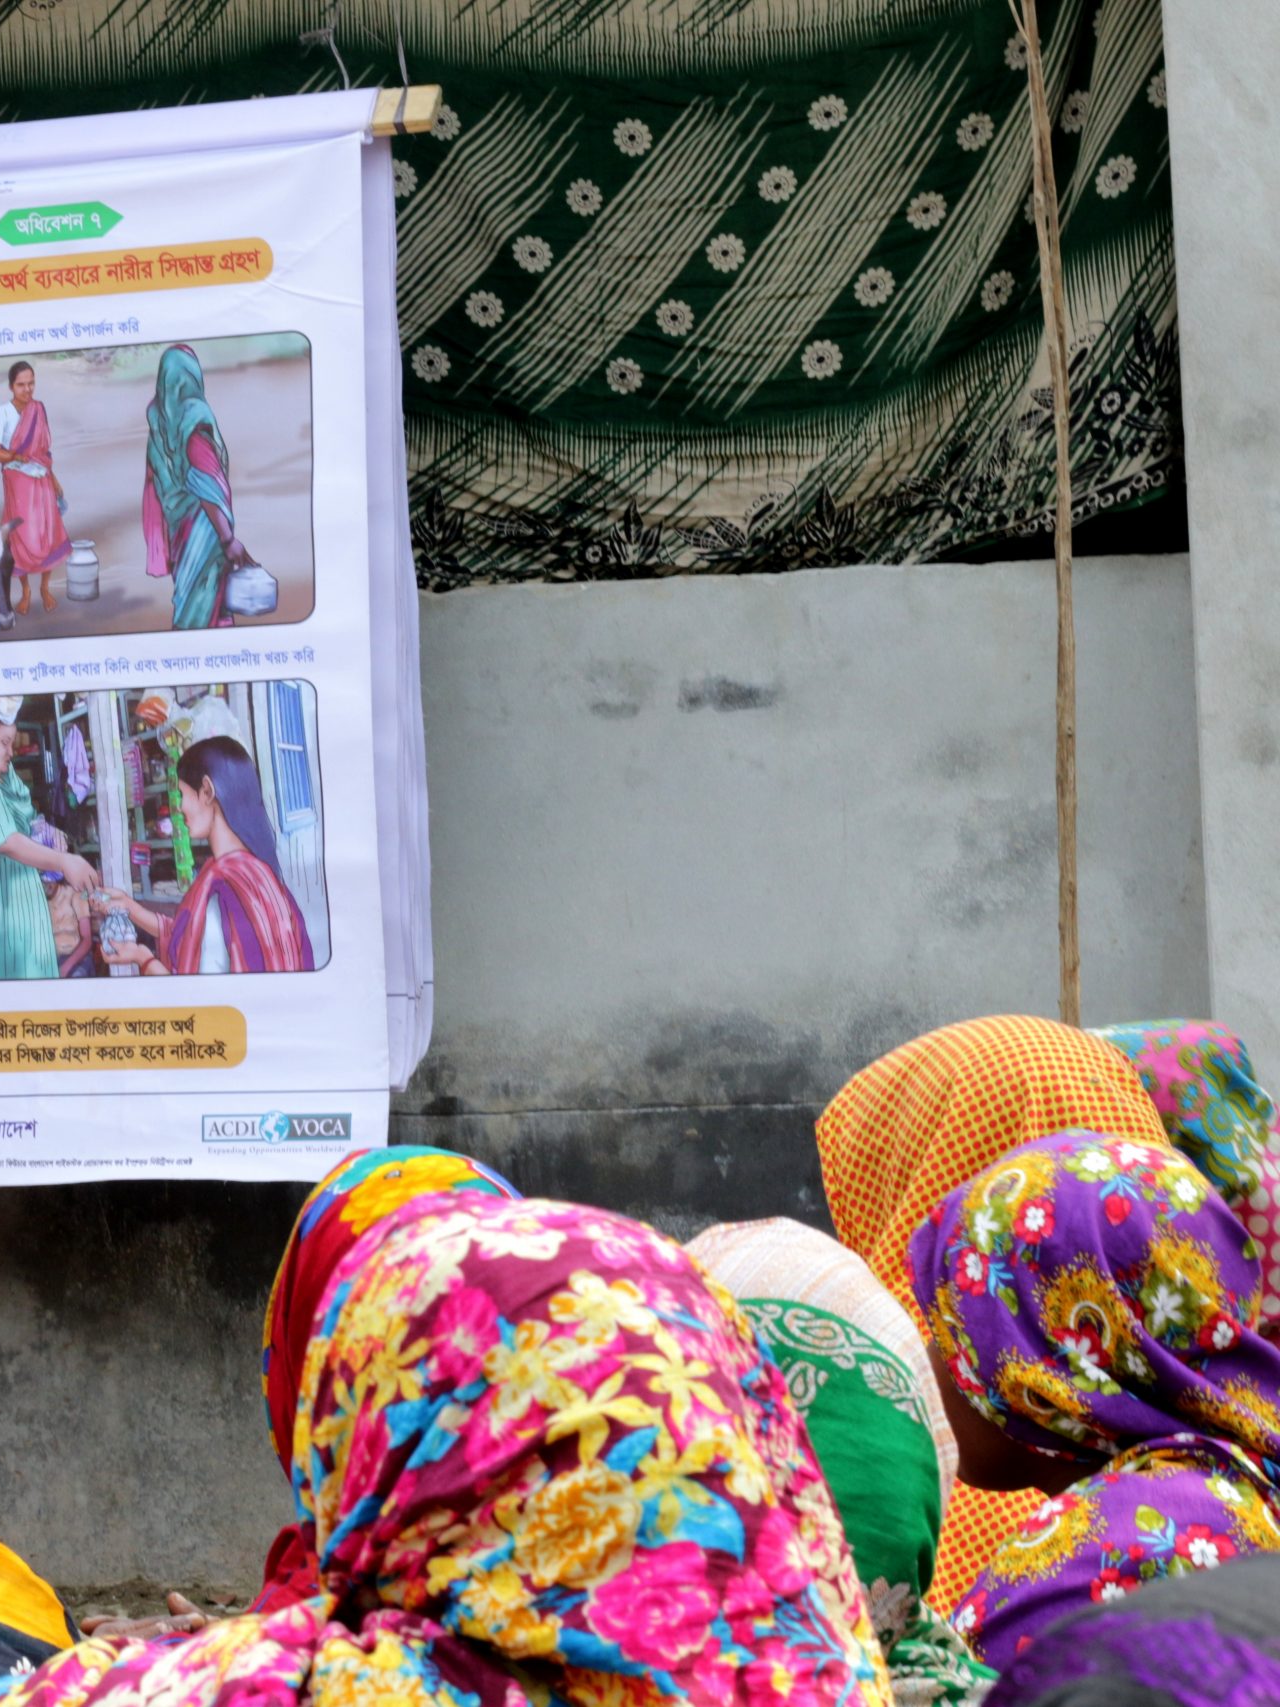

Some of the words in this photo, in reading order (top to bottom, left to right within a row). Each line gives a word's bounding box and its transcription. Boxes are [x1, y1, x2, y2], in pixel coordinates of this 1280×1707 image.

[14, 211, 85, 236] অধিবেশন
[90, 211, 102, 230] ৭
[0, 264, 30, 291] অর্থ
[34, 264, 101, 289] ব্যবহারে
[104, 254, 154, 283] নারীর
[158, 251, 217, 279] সিদ্ধান্ত
[218, 248, 262, 274] গ্রহণ
[17, 328, 46, 343] এখন
[48, 323, 69, 340] অর্থ
[72, 319, 114, 338] উপার্জন
[117, 316, 140, 334] করি
[2, 666, 24, 681] জন্য
[28, 661, 66, 682] পুষ্টিকর
[69, 661, 101, 677] খাবার
[104, 657, 130, 674] কিনি
[134, 658, 159, 673] এবং
[161, 655, 200, 671] অন্যান্য
[293, 646, 316, 664] করি
[21, 1018, 62, 1039] নিজের
[66, 1015, 120, 1038] উপার্জিত
[169, 1013, 196, 1036] অর্থ
[16, 1044, 56, 1064] সিদ্ধান্ত
[59, 1044, 91, 1064] গ্রহণ
[95, 1044, 135, 1062] করতে
[140, 1043, 166, 1062] হবে
[169, 1039, 229, 1062] নারীকেই
[208, 1120, 257, 1138] ACDI
[291, 1118, 346, 1137] VOCA
